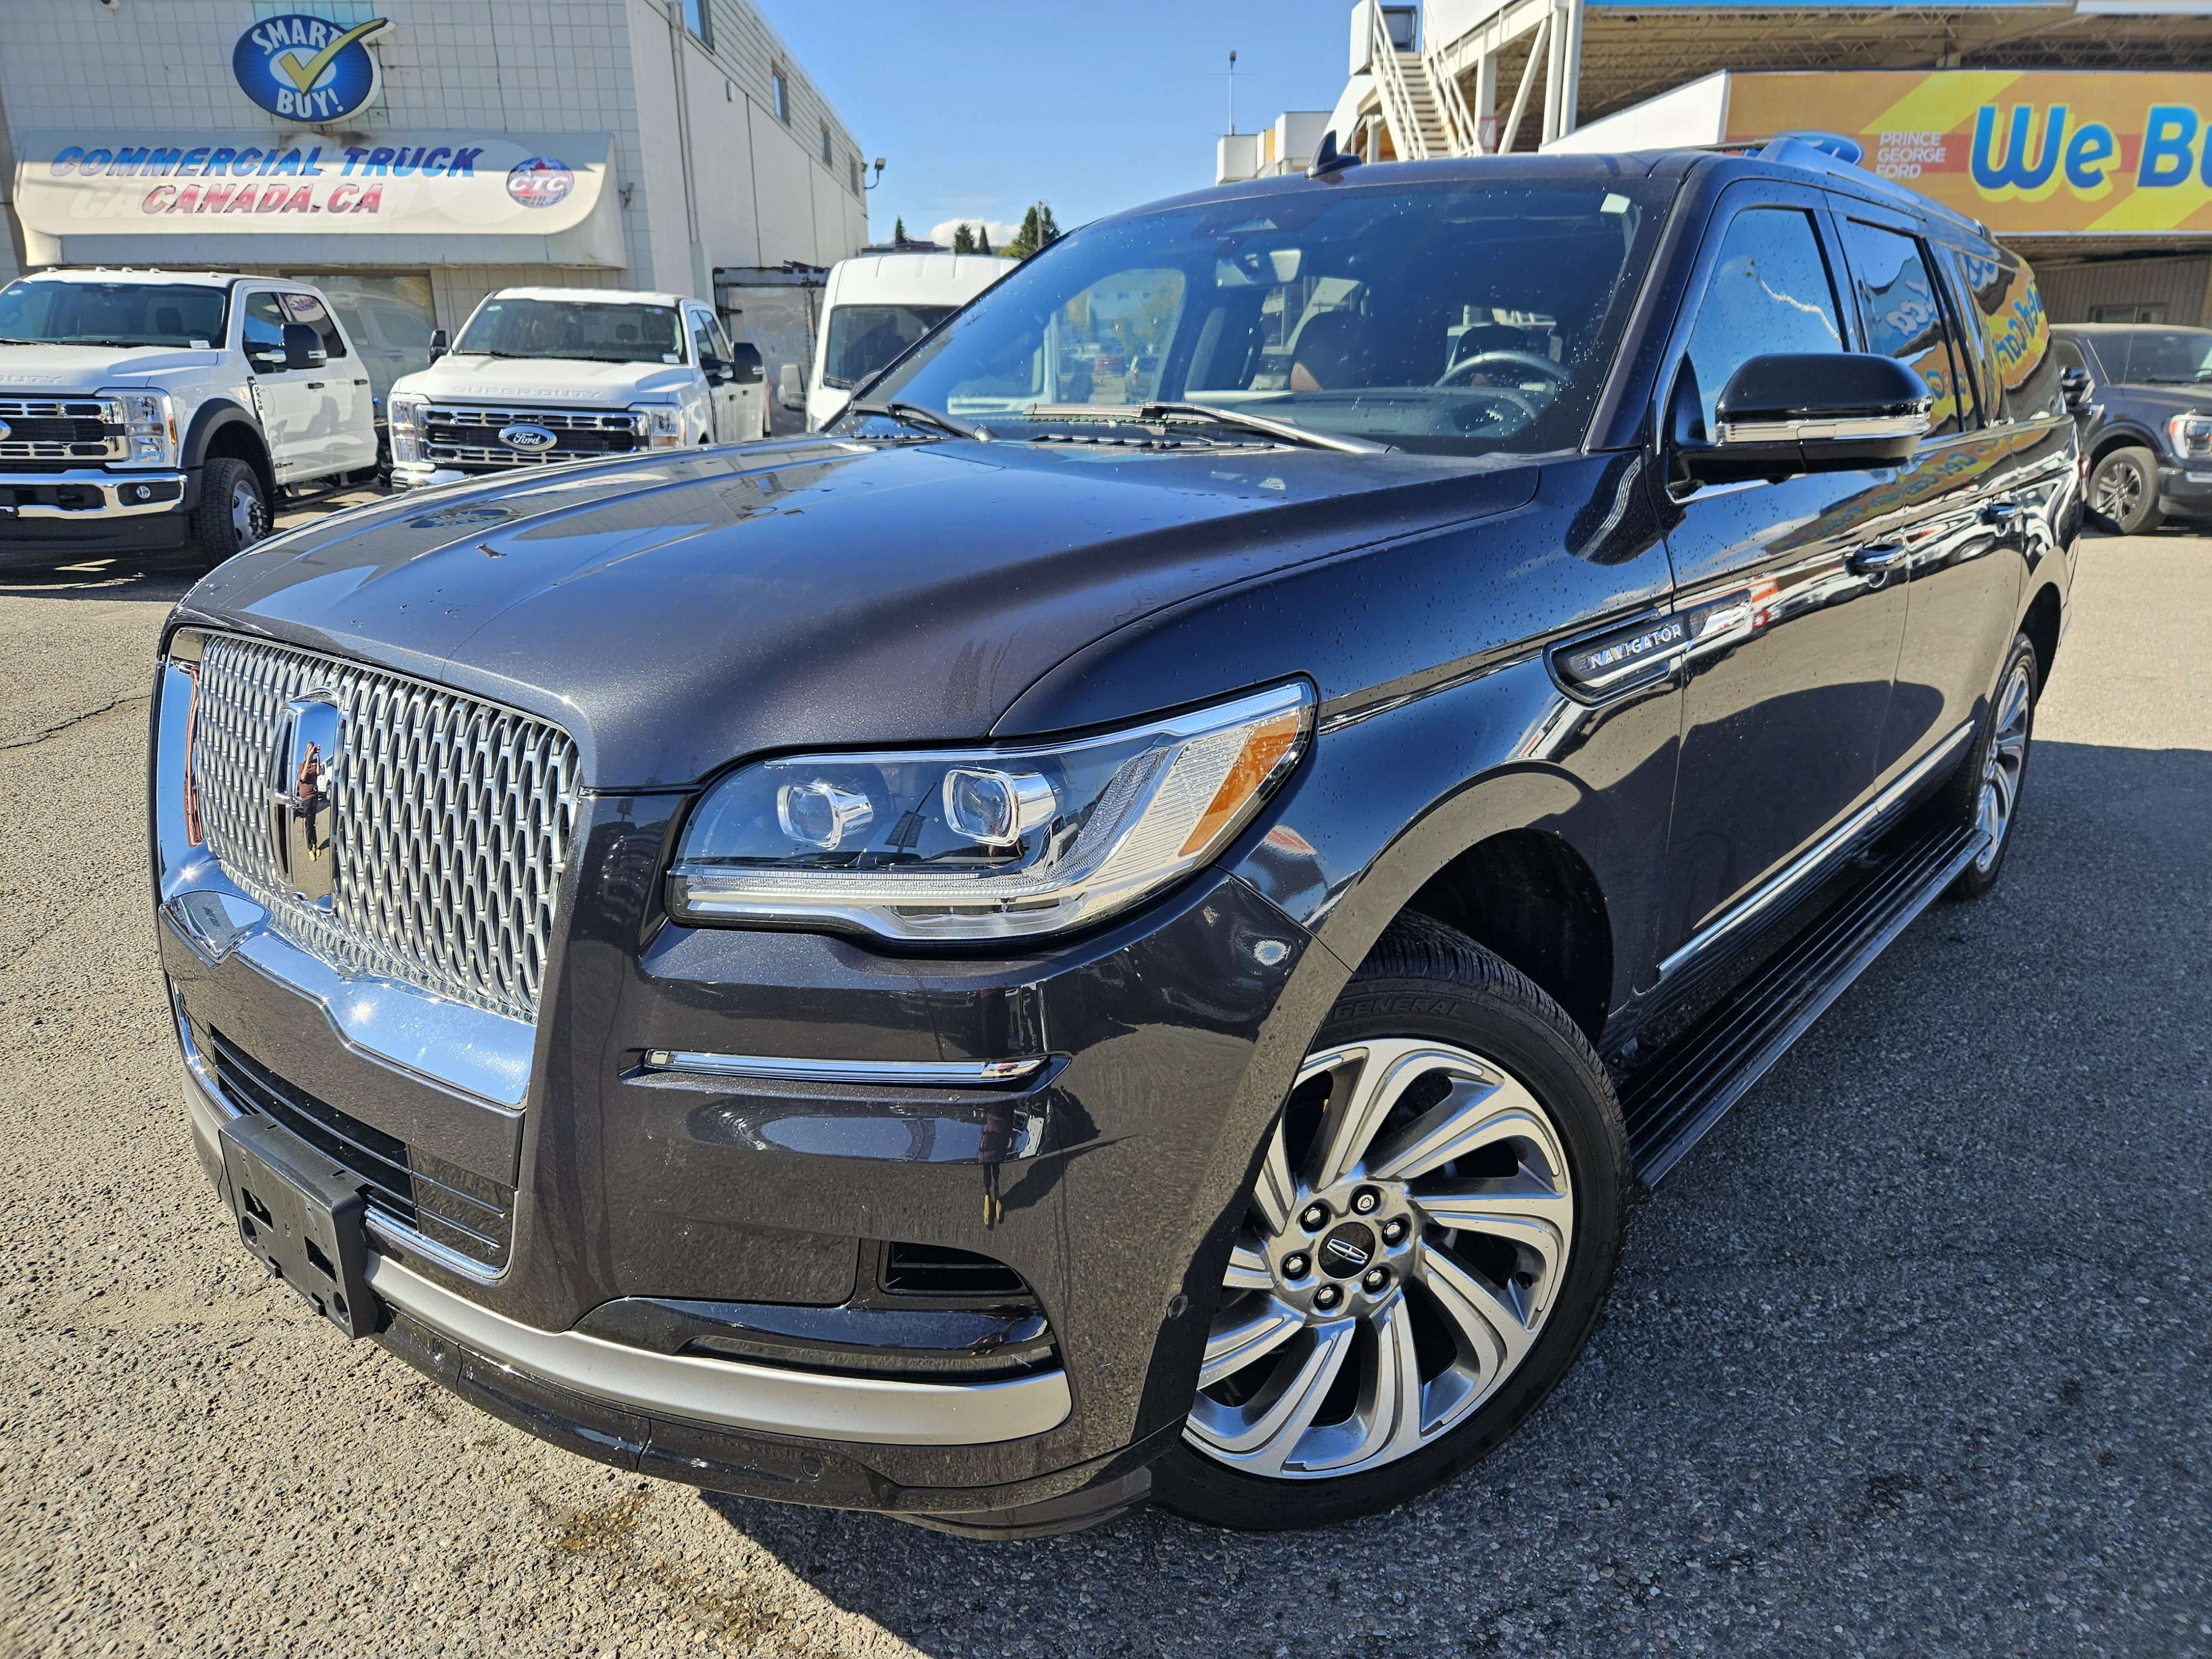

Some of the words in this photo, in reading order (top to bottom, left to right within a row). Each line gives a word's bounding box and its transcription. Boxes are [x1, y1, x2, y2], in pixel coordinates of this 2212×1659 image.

[251, 18, 345, 55] SMART
[276, 87, 343, 118] BUY!
[1879, 131, 1942, 147] PRINCE
[1971, 105, 2114, 190] We
[50, 146, 325, 177] COMMERCIAL
[340, 147, 484, 178] TRUCK
[1877, 147, 1946, 163] GEORGE
[1875, 163, 1922, 179] FORD
[509, 176, 568, 191] CTC
[142, 184, 384, 214] CANADA.CA
[452, 385, 533, 397] SUPER
[538, 388, 603, 399] DUTY
[513, 432, 540, 445] Ford
[1590, 623, 1682, 669] NAVIGATOR
[1332, 997, 1461, 1020] GENERAL
